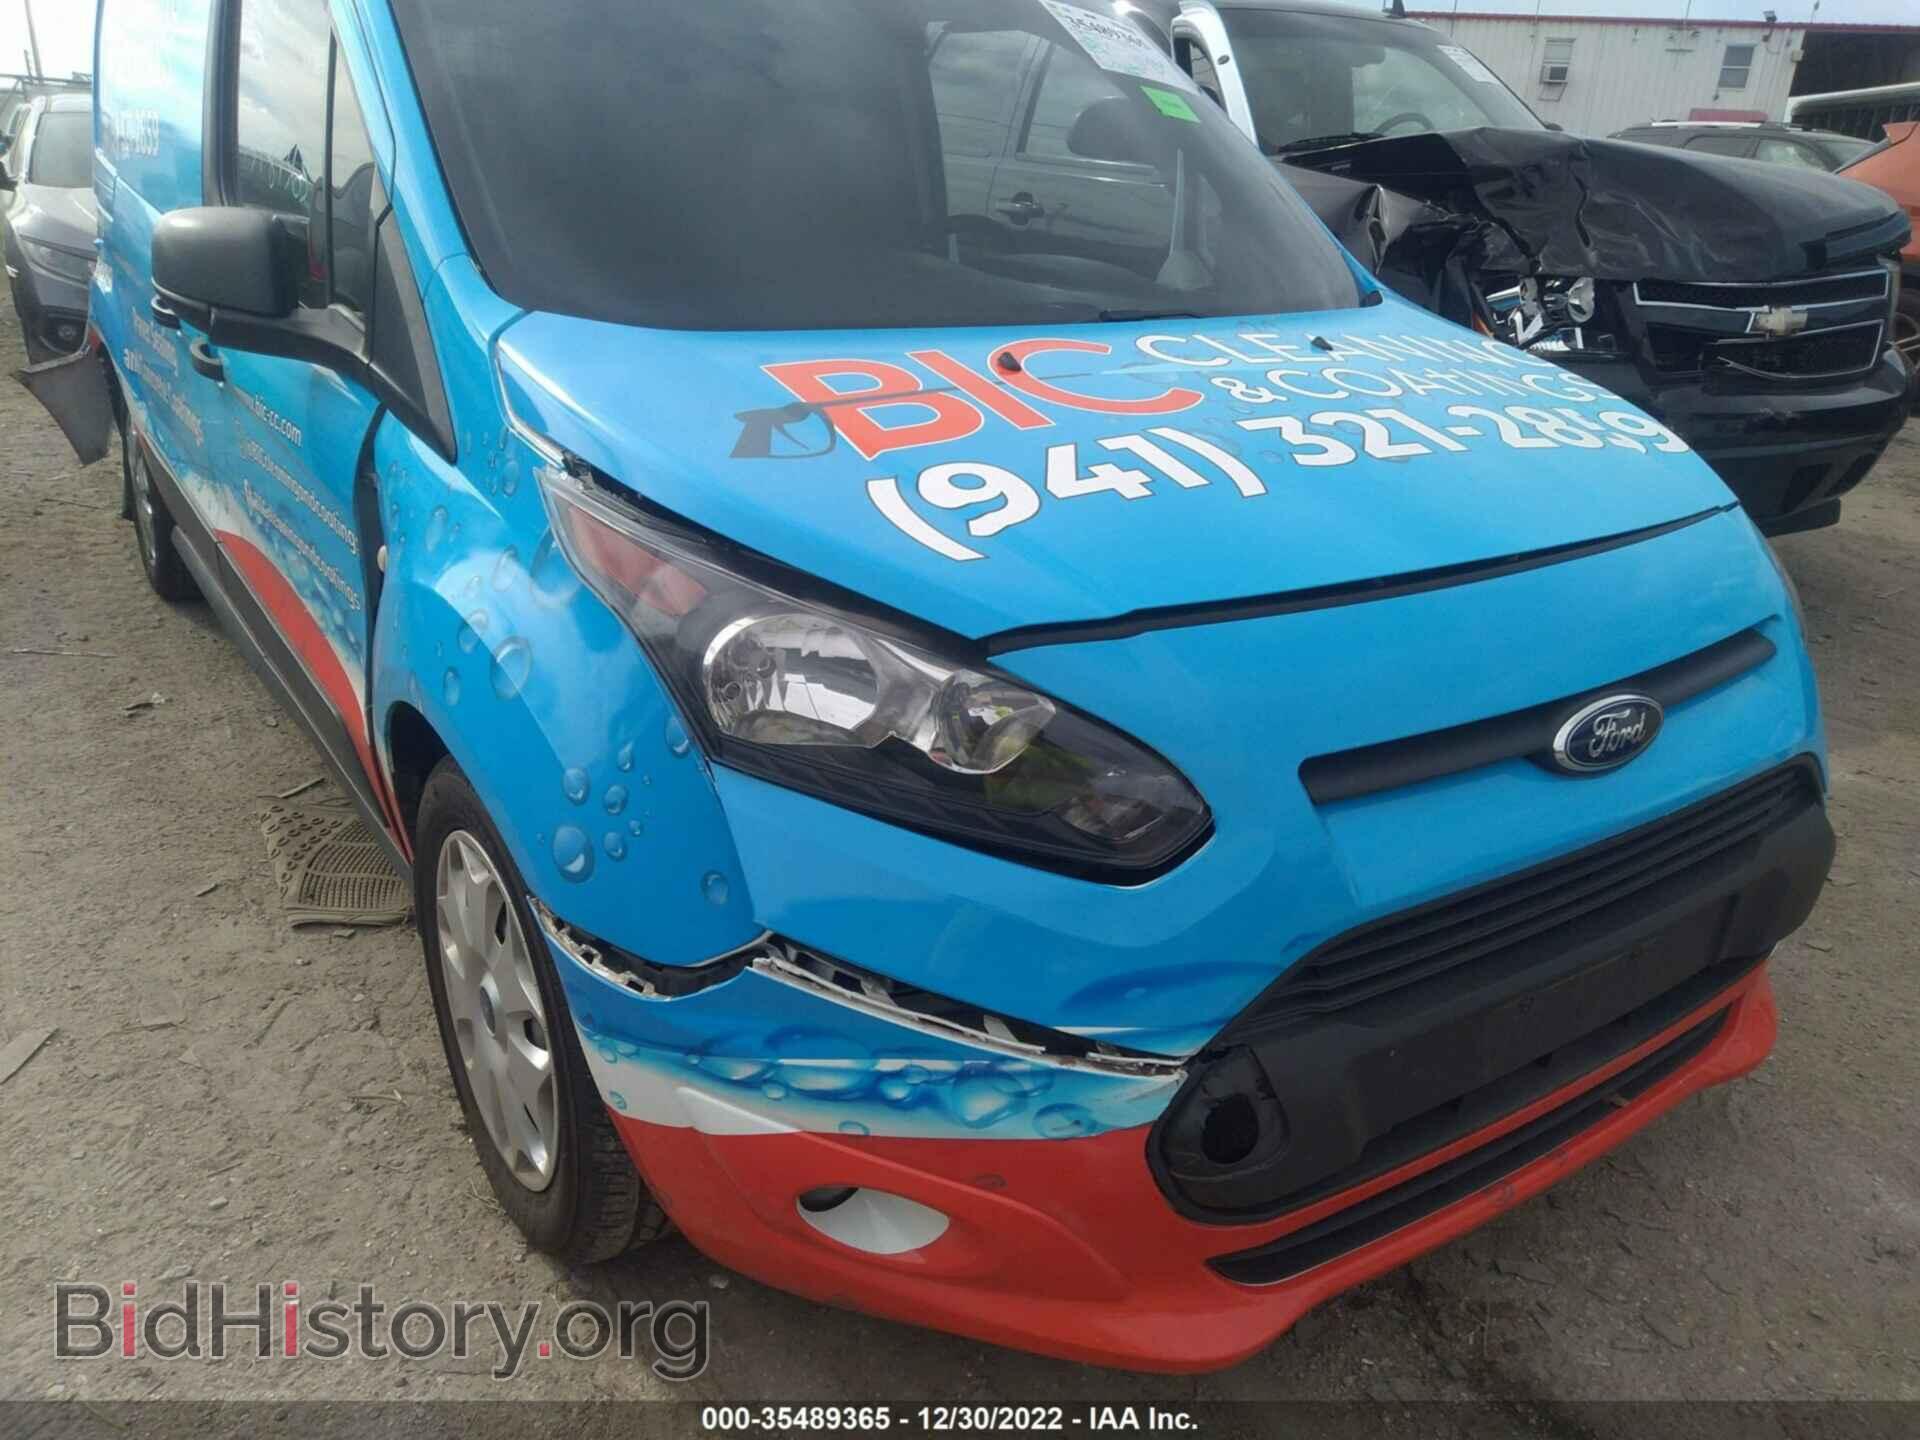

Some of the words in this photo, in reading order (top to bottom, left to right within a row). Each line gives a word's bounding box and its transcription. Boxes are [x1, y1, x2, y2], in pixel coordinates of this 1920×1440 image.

[761, 338, 1205, 461] BIC
[867, 426, 1268, 561] (941)
[1235, 405, 1691, 467] 321-2859
[1588, 708, 1648, 758] Ford
